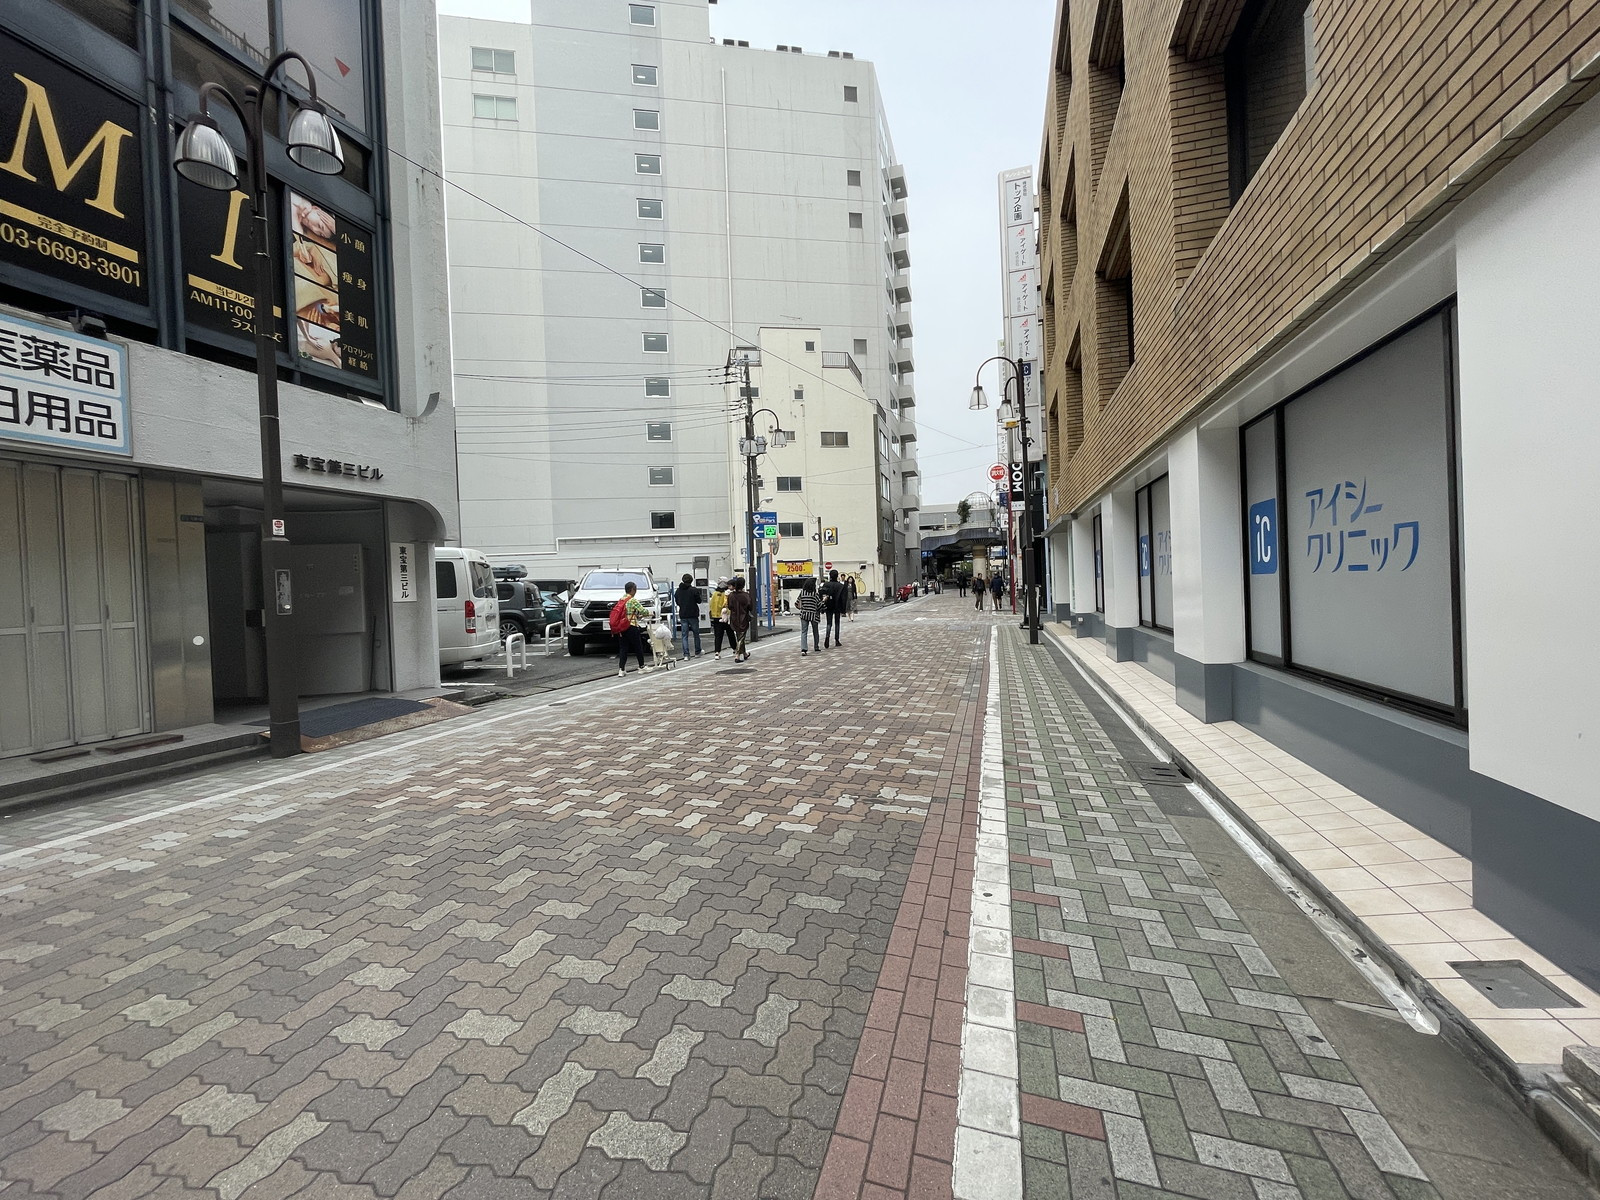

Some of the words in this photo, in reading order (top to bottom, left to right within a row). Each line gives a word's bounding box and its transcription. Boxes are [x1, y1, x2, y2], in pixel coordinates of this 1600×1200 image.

[0, 72, 134, 219] M
[210, 189, 250, 270] I
[37, 215, 109, 251] 完全予約制
[340, 232, 366, 254] 小顔
[0, 222, 140, 287] 03-6693-3901
[190, 290, 256, 319] AM11:00
[344, 310, 369, 330] 美肌
[293, 454, 384, 480] 東宝第三ビル
[1305, 476, 1383, 530] アイシー
[825, 529, 832, 541] P
[1306, 520, 1420, 574] クリニック
[398, 546, 410, 599] 東宝第三ビル
